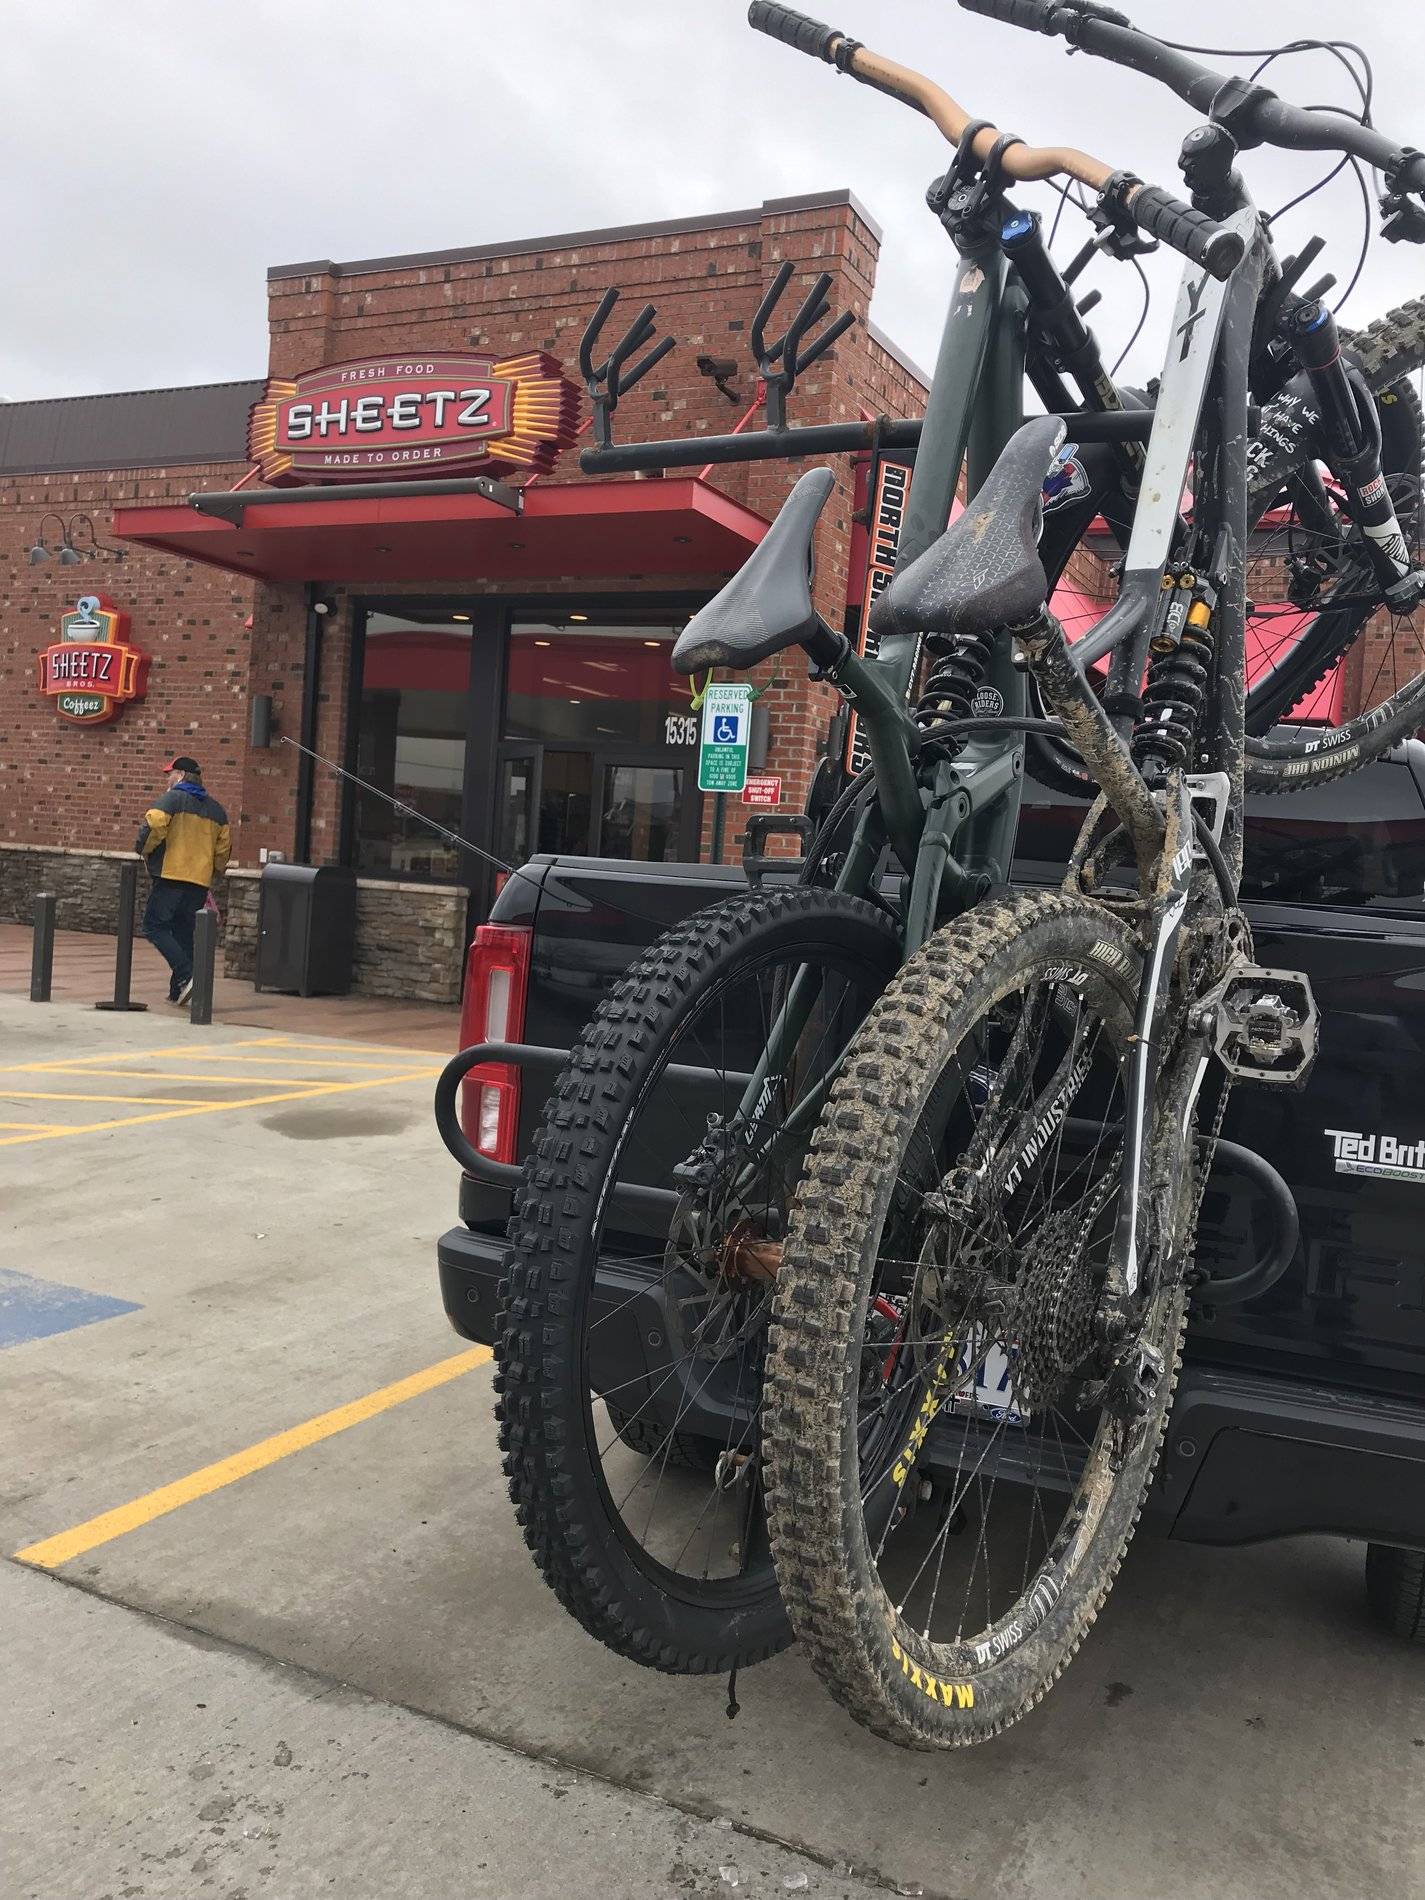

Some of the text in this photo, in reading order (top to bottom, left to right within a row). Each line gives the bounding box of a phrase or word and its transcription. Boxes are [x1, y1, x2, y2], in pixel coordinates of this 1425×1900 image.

[341, 364, 435, 382] FRESH FOOD
[287, 389, 491, 440] SHEETZ
[1277, 393, 1320, 425] WHY WE
[324, 448, 442, 464] MADE TO ORDER
[52, 651, 113, 680] SHEETZ
[63, 697, 100, 715] Coffeez
[708, 689, 749, 701] RESERVED
[710, 702, 745, 714] PARKING
[664, 716, 698, 746] 15315
[1304, 729, 1351, 754] DT SWISS
[1310, 744, 1361, 774] MINION
[1324, 1128, 1376, 1162] Ted
[975, 1620, 1023, 1664] DT SWISS
[892, 1635, 974, 1709] MAXXIS
